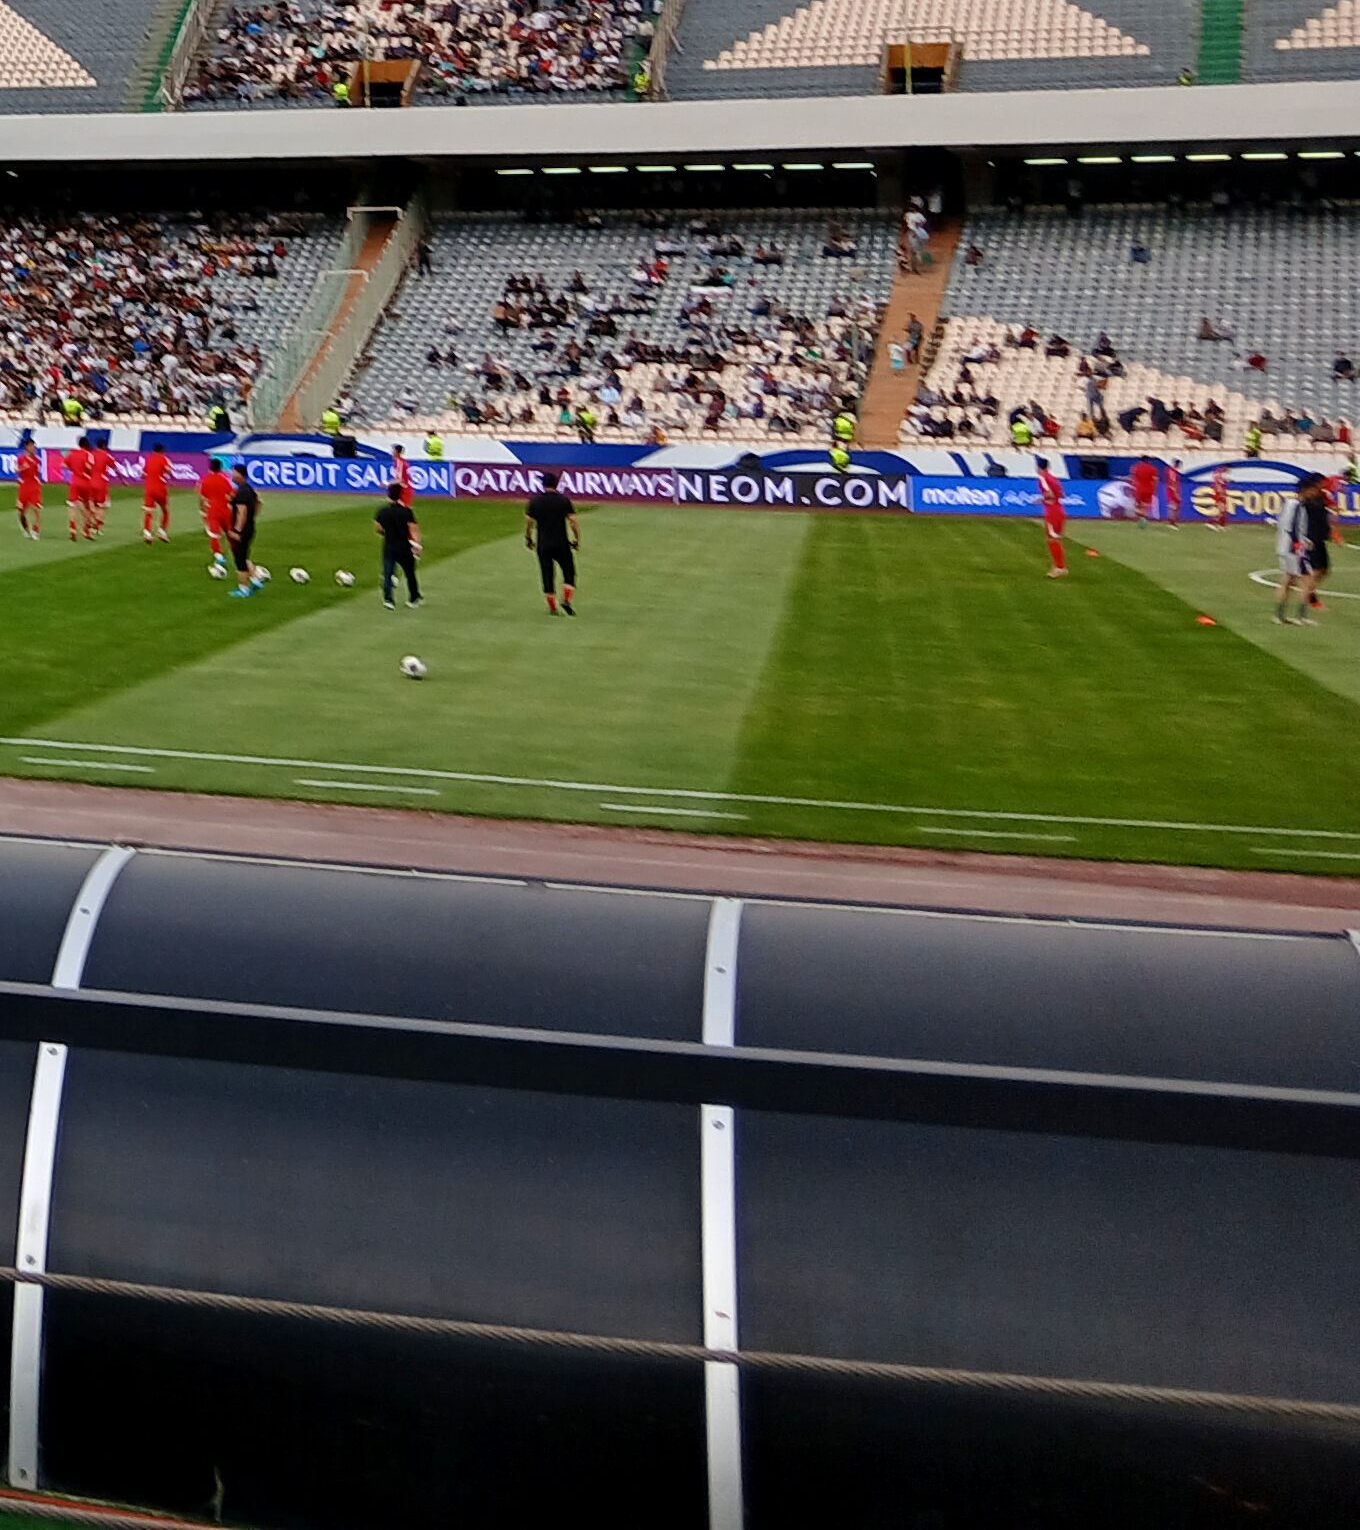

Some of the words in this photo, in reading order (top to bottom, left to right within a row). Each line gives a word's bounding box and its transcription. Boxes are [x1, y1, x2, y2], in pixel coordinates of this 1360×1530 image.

[247, 460, 341, 488] CREDIT
[455, 468, 545, 496] QATAR
[556, 470, 675, 498] AIRWAYS
[679, 473, 910, 508] NEOM.COM
